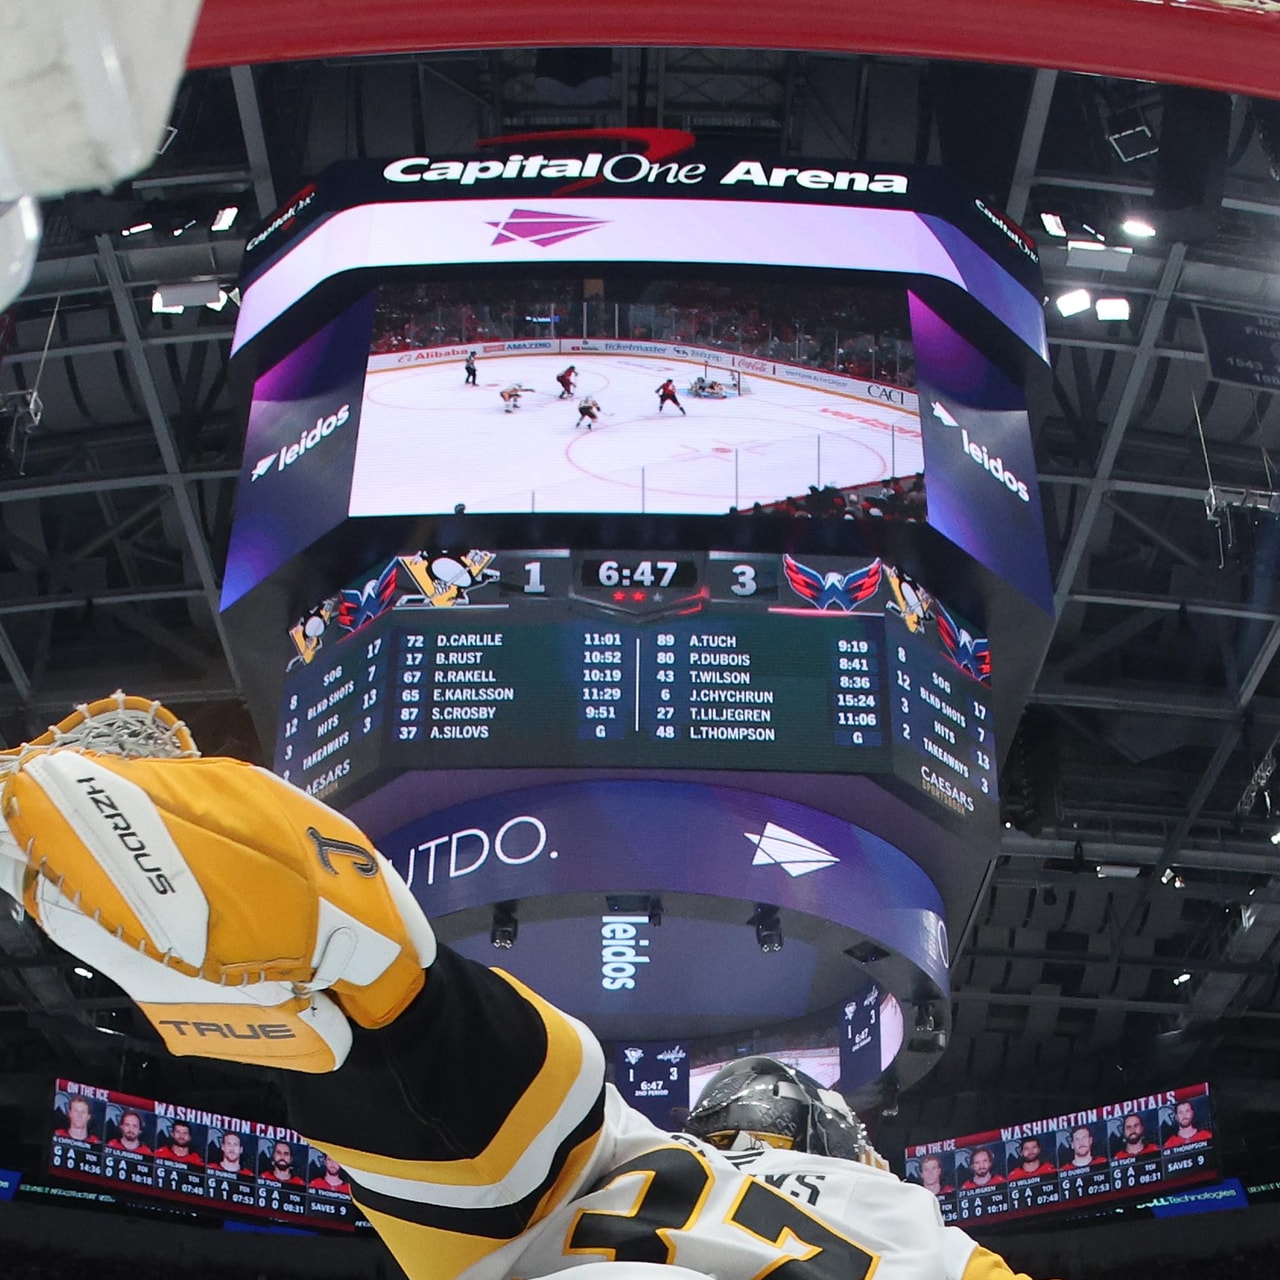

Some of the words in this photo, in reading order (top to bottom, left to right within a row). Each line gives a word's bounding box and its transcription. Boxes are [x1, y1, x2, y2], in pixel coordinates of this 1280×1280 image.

[720, 161, 909, 193] Arena
[415, 347, 468, 361] Alibaba
[867, 384, 904, 405] CACI
[277, 404, 350, 472] leidos
[962, 429, 1030, 502] leidos
[523, 561, 546, 593] 1
[598, 560, 678, 587] 6:47
[731, 564, 757, 596] 3
[407, 635, 424, 648] 72
[437, 634, 503, 646] D.CARLILE
[584, 633, 622, 646] 11:01
[656, 634, 675, 646] 89
[689, 635, 737, 648] A.TUCH
[838, 640, 868, 653] 9:19
[405, 653, 423, 665] 17
[436, 652, 483, 664] B.RUST
[583, 651, 622, 664] 10:52
[656, 652, 675, 665] 80
[689, 653, 750, 667] P.DUBOIS
[839, 658, 869, 671] 8:41
[323, 665, 343, 687] SOG
[403, 671, 421, 684] 67
[434, 670, 496, 683] R.RAKELL
[583, 669, 622, 682] 10:19
[656, 670, 674, 683] 43
[689, 671, 750, 685] T.WILSON
[839, 676, 870, 689] 8:36
[897, 647, 907, 663] 8
[931, 671, 951, 695] SOG
[973, 701, 986, 720] 17
[328, 680, 355, 706] SHOTS
[402, 689, 420, 702] 65
[433, 687, 514, 701] E.KARLSSON
[583, 687, 622, 700] 11:29
[661, 688, 670, 701] 6
[689, 689, 774, 704] J.CHYCHRUN
[837, 694, 876, 708] 15:24
[400, 708, 419, 721] 87
[431, 706, 496, 720] S.CROSBY
[585, 706, 616, 719] 9:51
[656, 707, 674, 720] 27
[689, 707, 771, 722] T.LILJEGREN
[838, 712, 877, 726] 11:06
[896, 670, 912, 692] 12
[941, 701, 967, 729] SHOTS
[977, 727, 985, 743] 7
[317, 714, 339, 738] HITS
[399, 727, 417, 740] 37
[430, 725, 489, 740] A.SILOVS
[595, 725, 606, 738] G
[656, 726, 675, 739] 48
[689, 726, 775, 741] L.THOMPSON
[852, 731, 864, 744] G
[901, 697, 909, 714] 3
[934, 720, 956, 745] HITS
[976, 750, 990, 771] 13
[302, 731, 350, 771] TAKEAWAYS
[903, 723, 911, 740] 2
[923, 737, 969, 779] TAKEAWAYS
[980, 777, 989, 794] 3
[305, 758, 351, 796] AESARS
[920, 765, 975, 812] CAESARS
[601, 915, 650, 990] leidos
[159, 1019, 297, 1041] TRUE
[66, 1083, 78, 1095] ON
[80, 1085, 95, 1098] THE
[96, 1087, 110, 1101] ICE
[640, 1081, 663, 1090] 6:47
[154, 1101, 251, 1137] WASHINGTON
[1000, 1108, 1098, 1142] WASHINGTON
[1102, 1090, 1177, 1120] CAPITALS
[915, 1143, 929, 1157] ON
[930, 1141, 943, 1155] THE
[943, 1139, 956, 1151] ICE
[1168, 1158, 1193, 1172] SAVES
[1197, 1155, 1205, 1165] 9
